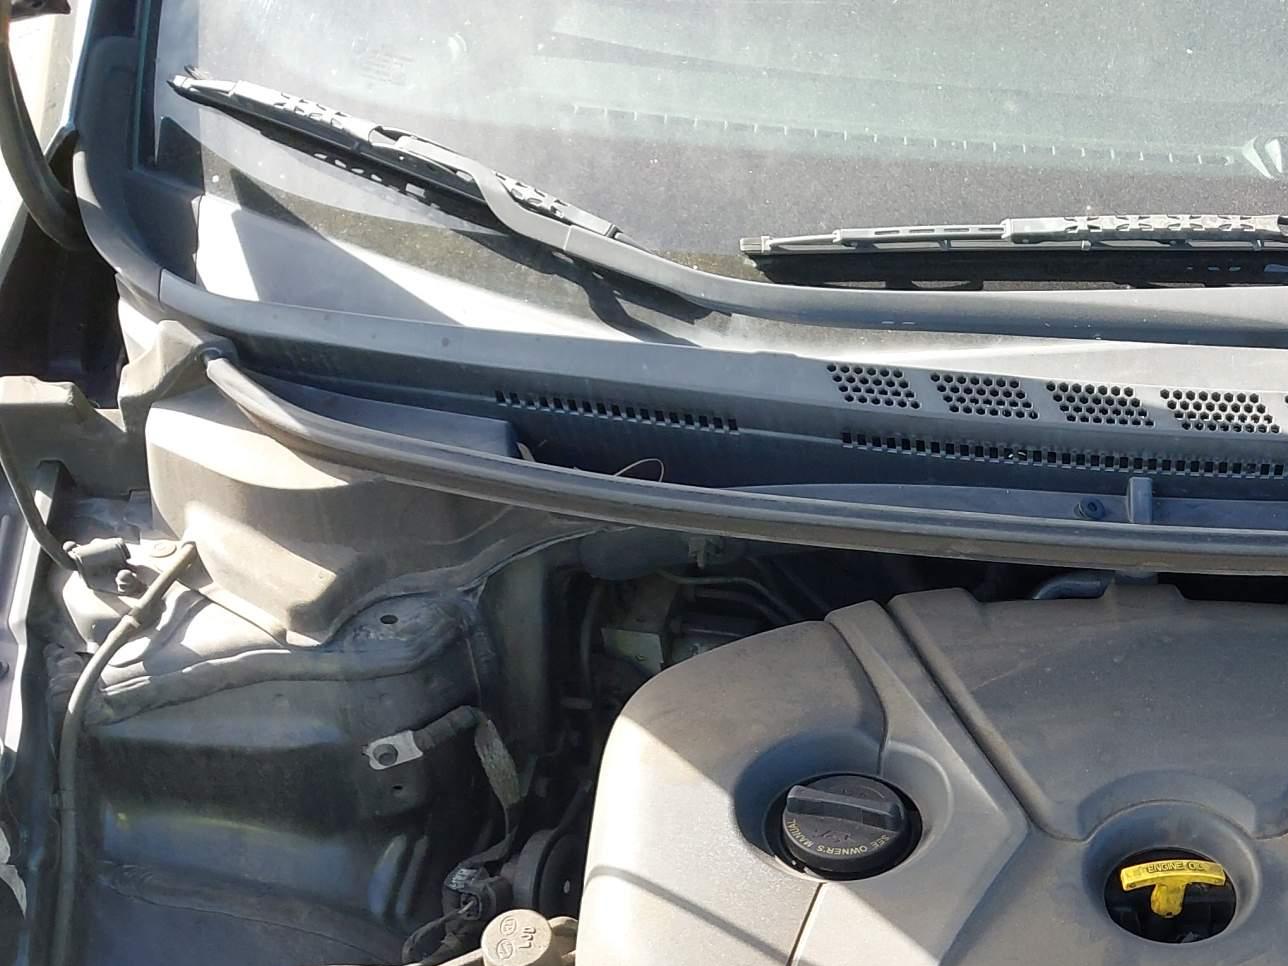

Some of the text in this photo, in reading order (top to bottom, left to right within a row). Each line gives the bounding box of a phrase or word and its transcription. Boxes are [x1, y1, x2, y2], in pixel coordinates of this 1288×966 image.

[787, 819, 890, 856] SEE OWNER'S MANUAL
[1147, 860, 1185, 873] ENGINE
